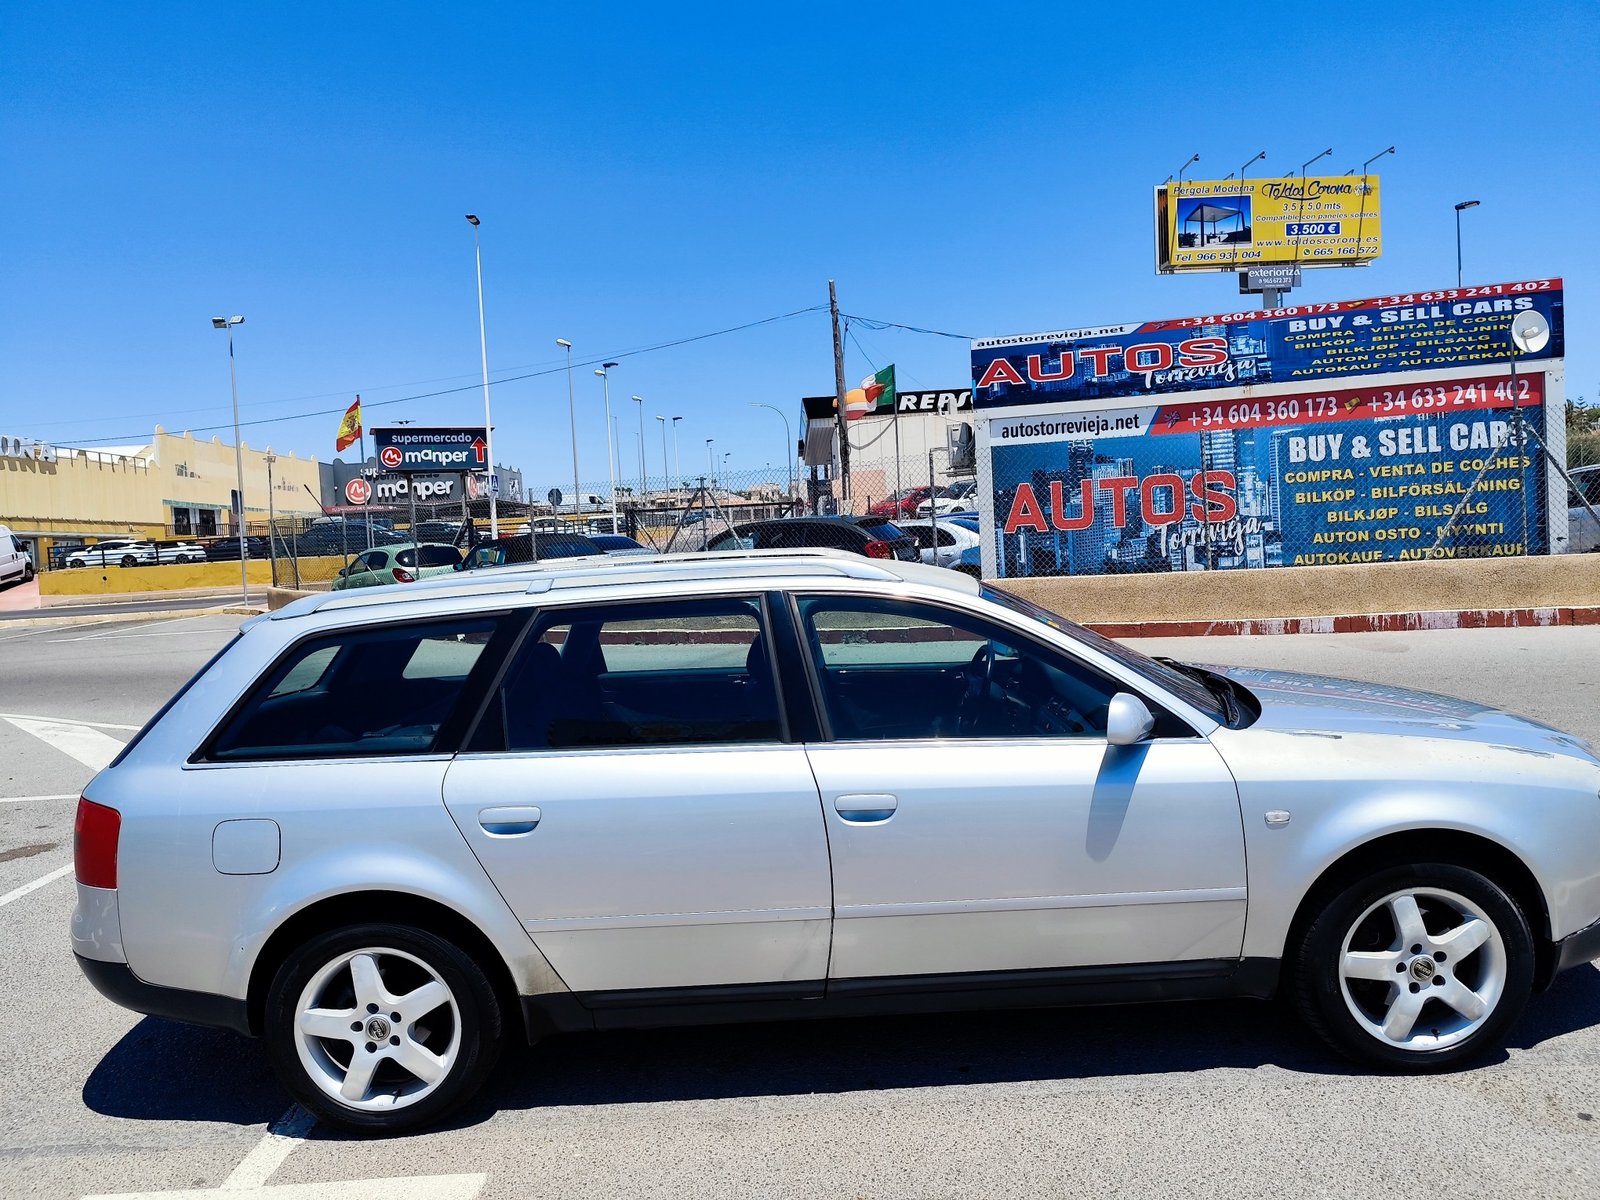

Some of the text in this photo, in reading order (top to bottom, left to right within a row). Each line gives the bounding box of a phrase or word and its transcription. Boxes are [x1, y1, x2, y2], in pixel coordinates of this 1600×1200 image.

[1213, 184, 1255, 194] Moderna
[1308, 180, 1352, 197] Corona
[1256, 213, 1299, 222] Compatible
[1283, 202, 1297, 212] 3,5
[1308, 202, 1322, 211] 5,0
[1290, 223, 1338, 235] 3.500 €
[1256, 236, 1378, 247] www.toldoscorona.es
[1313, 246, 1378, 256] 665 166 572
[1196, 252, 1217, 261] 966
[1219, 251, 1238, 260] 931
[1241, 250, 1262, 259] 004
[1248, 267, 1301, 277] exterioriza
[1372, 280, 1551, 308] +34 633 241 402
[1177, 302, 1340, 328] +34 604 360 173
[1288, 296, 1534, 333] BUY & SELL CARS
[976, 325, 1126, 348] autostorrevieja.net
[1283, 329, 1354, 343] COMPRA
[1371, 321, 1427, 333] VENTA
[1433, 319, 1457, 328] DE
[1462, 313, 1518, 324] COCH
[1294, 337, 1355, 350] BILKÖP
[1371, 323, 1511, 342] BILFÖRSÄLJNIN
[1311, 354, 1369, 366] AUTON
[1375, 349, 1421, 360] OSTO
[1437, 341, 1507, 354] MYYNTI
[1326, 343, 1399, 355] BILKJØP
[1415, 334, 1491, 348] BILSALG
[976, 336, 1229, 388] AUTOS
[1291, 362, 1382, 376] AUTOKAUF
[1139, 359, 1256, 389] Torrevieja
[899, 391, 973, 411] REPS
[1367, 390, 1407, 412] +34
[1411, 386, 1447, 409] 633
[1452, 382, 1487, 406] 241
[1187, 396, 1338, 427] +34 604 360 173
[1001, 413, 1140, 440] autostorrevieja.net
[391, 432, 472, 446] supermercado
[1288, 433, 1345, 464] BUY
[1351, 434, 1372, 460] &
[1378, 425, 1443, 457] SELL
[405, 449, 469, 466] manper
[1284, 468, 1354, 484] COMPRA
[1369, 463, 1426, 478] VENTA
[1431, 461, 1454, 474] DE
[377, 479, 454, 500] manper
[1295, 487, 1356, 504] BILKÖP
[1371, 478, 1521, 499] BILFÖRSÄLNING
[1003, 469, 1238, 535] AUTOS
[1327, 507, 1398, 523] BILKJØP
[1414, 501, 1488, 518] BILSLG
[1313, 530, 1369, 544] AUTON
[1375, 527, 1421, 541] OSTO
[1294, 550, 1383, 566] AUTOKAUF
